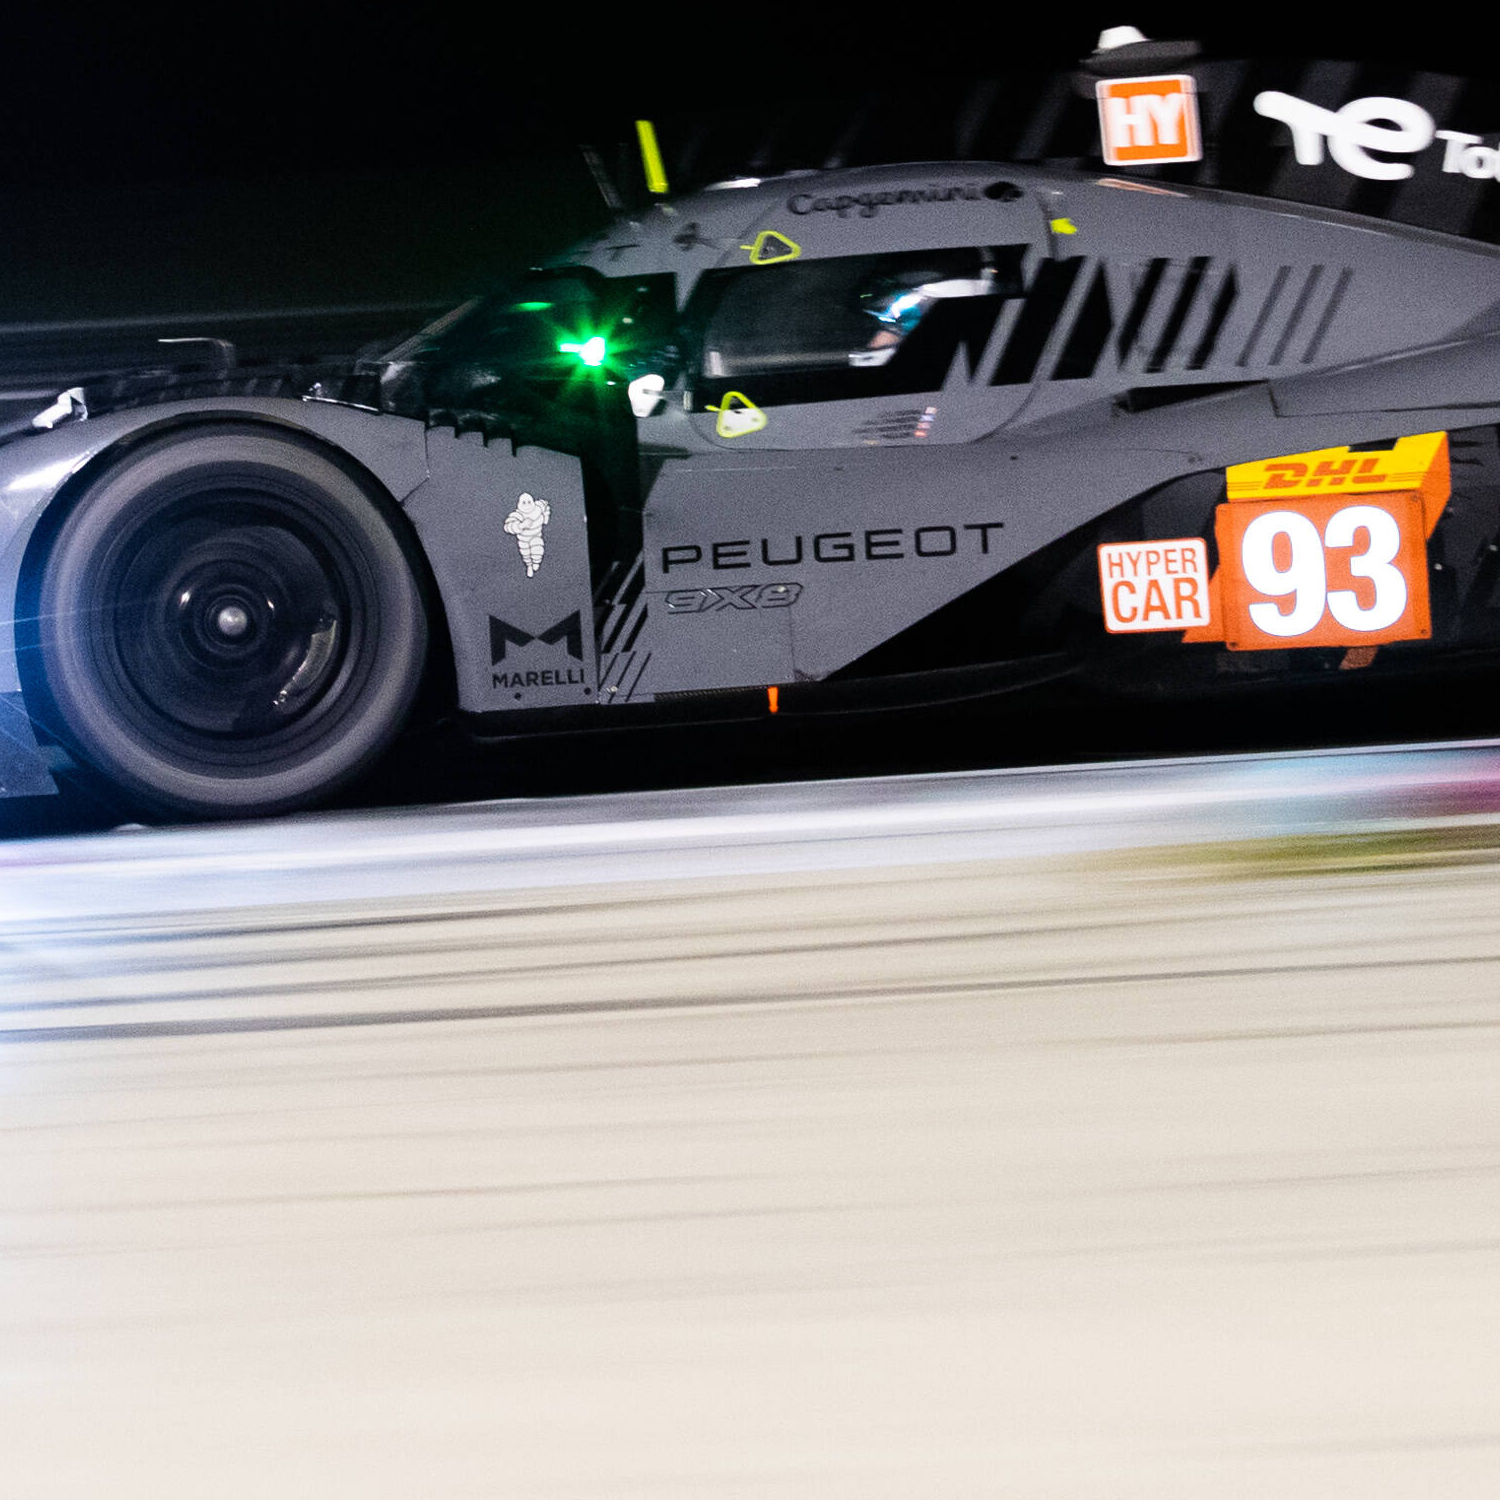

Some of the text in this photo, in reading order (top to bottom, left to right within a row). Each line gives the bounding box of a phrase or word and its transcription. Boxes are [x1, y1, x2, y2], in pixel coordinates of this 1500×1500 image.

[1106, 92, 1186, 148] HY
[1261, 457, 1389, 490] DHL
[661, 521, 1005, 574] PEUGEOT
[1107, 546, 1199, 579] HYPER
[1241, 505, 1408, 637] 93
[1111, 577, 1202, 624] CAR
[491, 668, 585, 689] MARELLI
